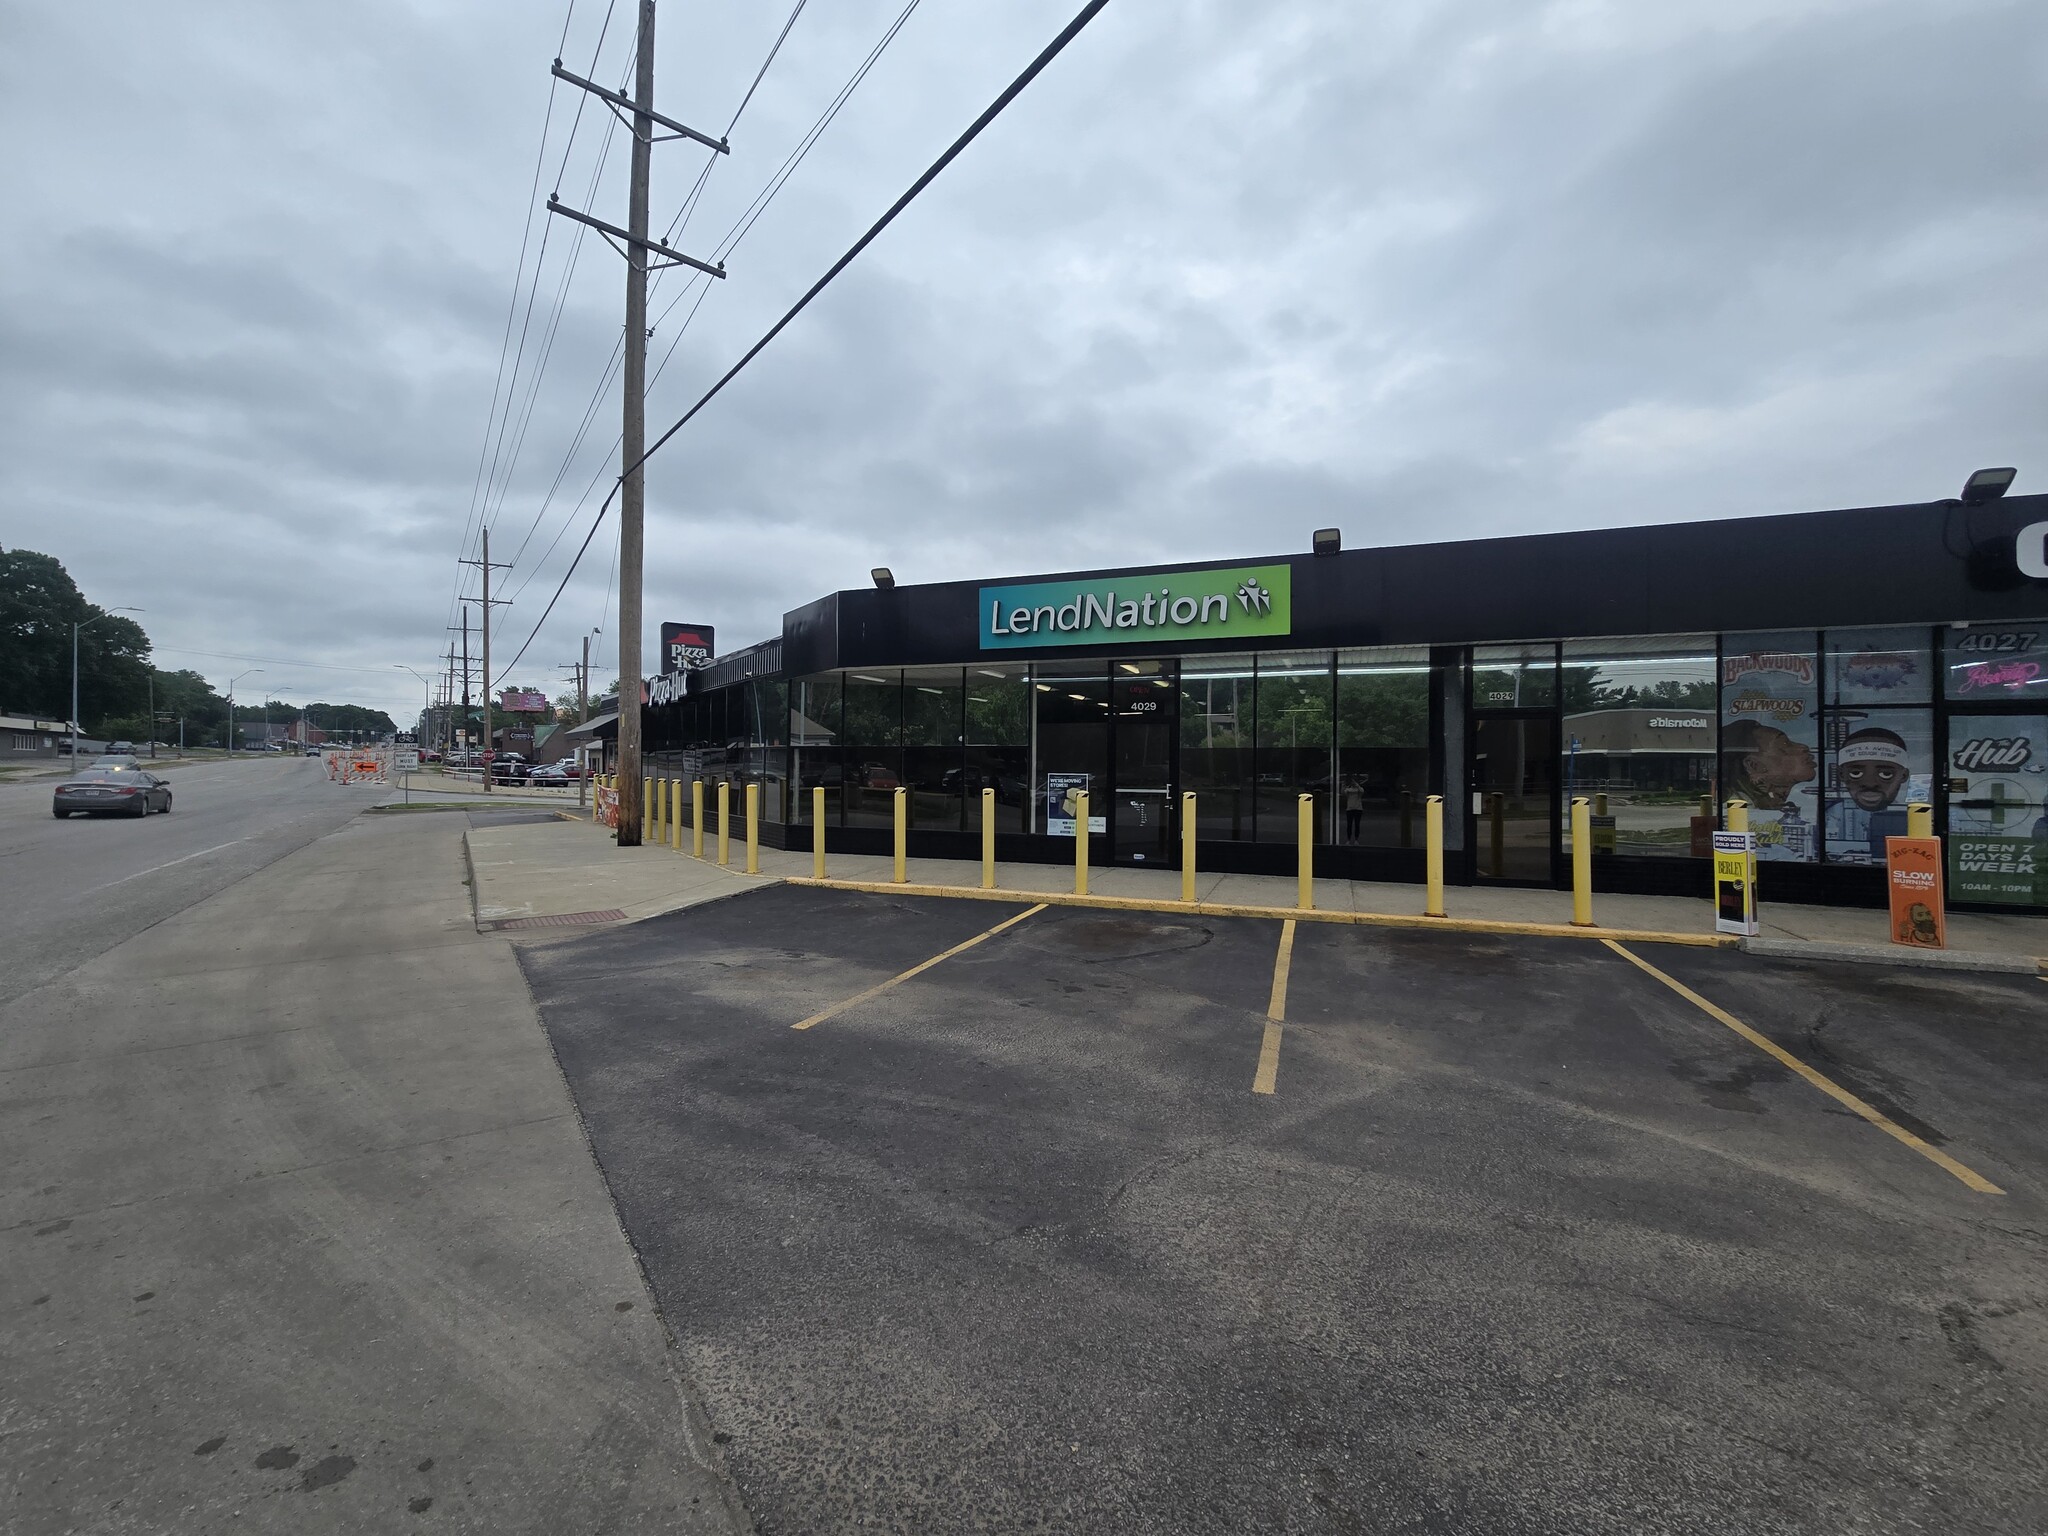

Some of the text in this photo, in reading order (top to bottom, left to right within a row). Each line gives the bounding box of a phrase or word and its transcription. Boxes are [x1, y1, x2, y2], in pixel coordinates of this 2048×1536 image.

[991, 588, 1229, 635] LendNation
[1958, 633, 2037, 651] 4027
[671, 644, 708, 658] Pizza
[672, 656, 701, 668] Ht
[1724, 653, 1811, 682] BACKWOODS
[648, 670, 688, 708] Pizza Hut
[1490, 692, 1513, 700] 4029
[1130, 702, 1157, 711] 4029
[1729, 699, 1804, 716] SLAPWOODS
[1891, 847, 1936, 860] ZIG-ZAG
[1960, 843, 2036, 853] OPEN 7
[1960, 853, 2033, 862] DAYS A
[1718, 860, 1744, 877] BERLEY
[1960, 862, 2038, 874] WEEK
[1893, 870, 1935, 881] SLOW
[1893, 878, 1935, 887] BURNING
[1960, 883, 1992, 891] 10AM
[2001, 884, 2032, 893] 10PM
